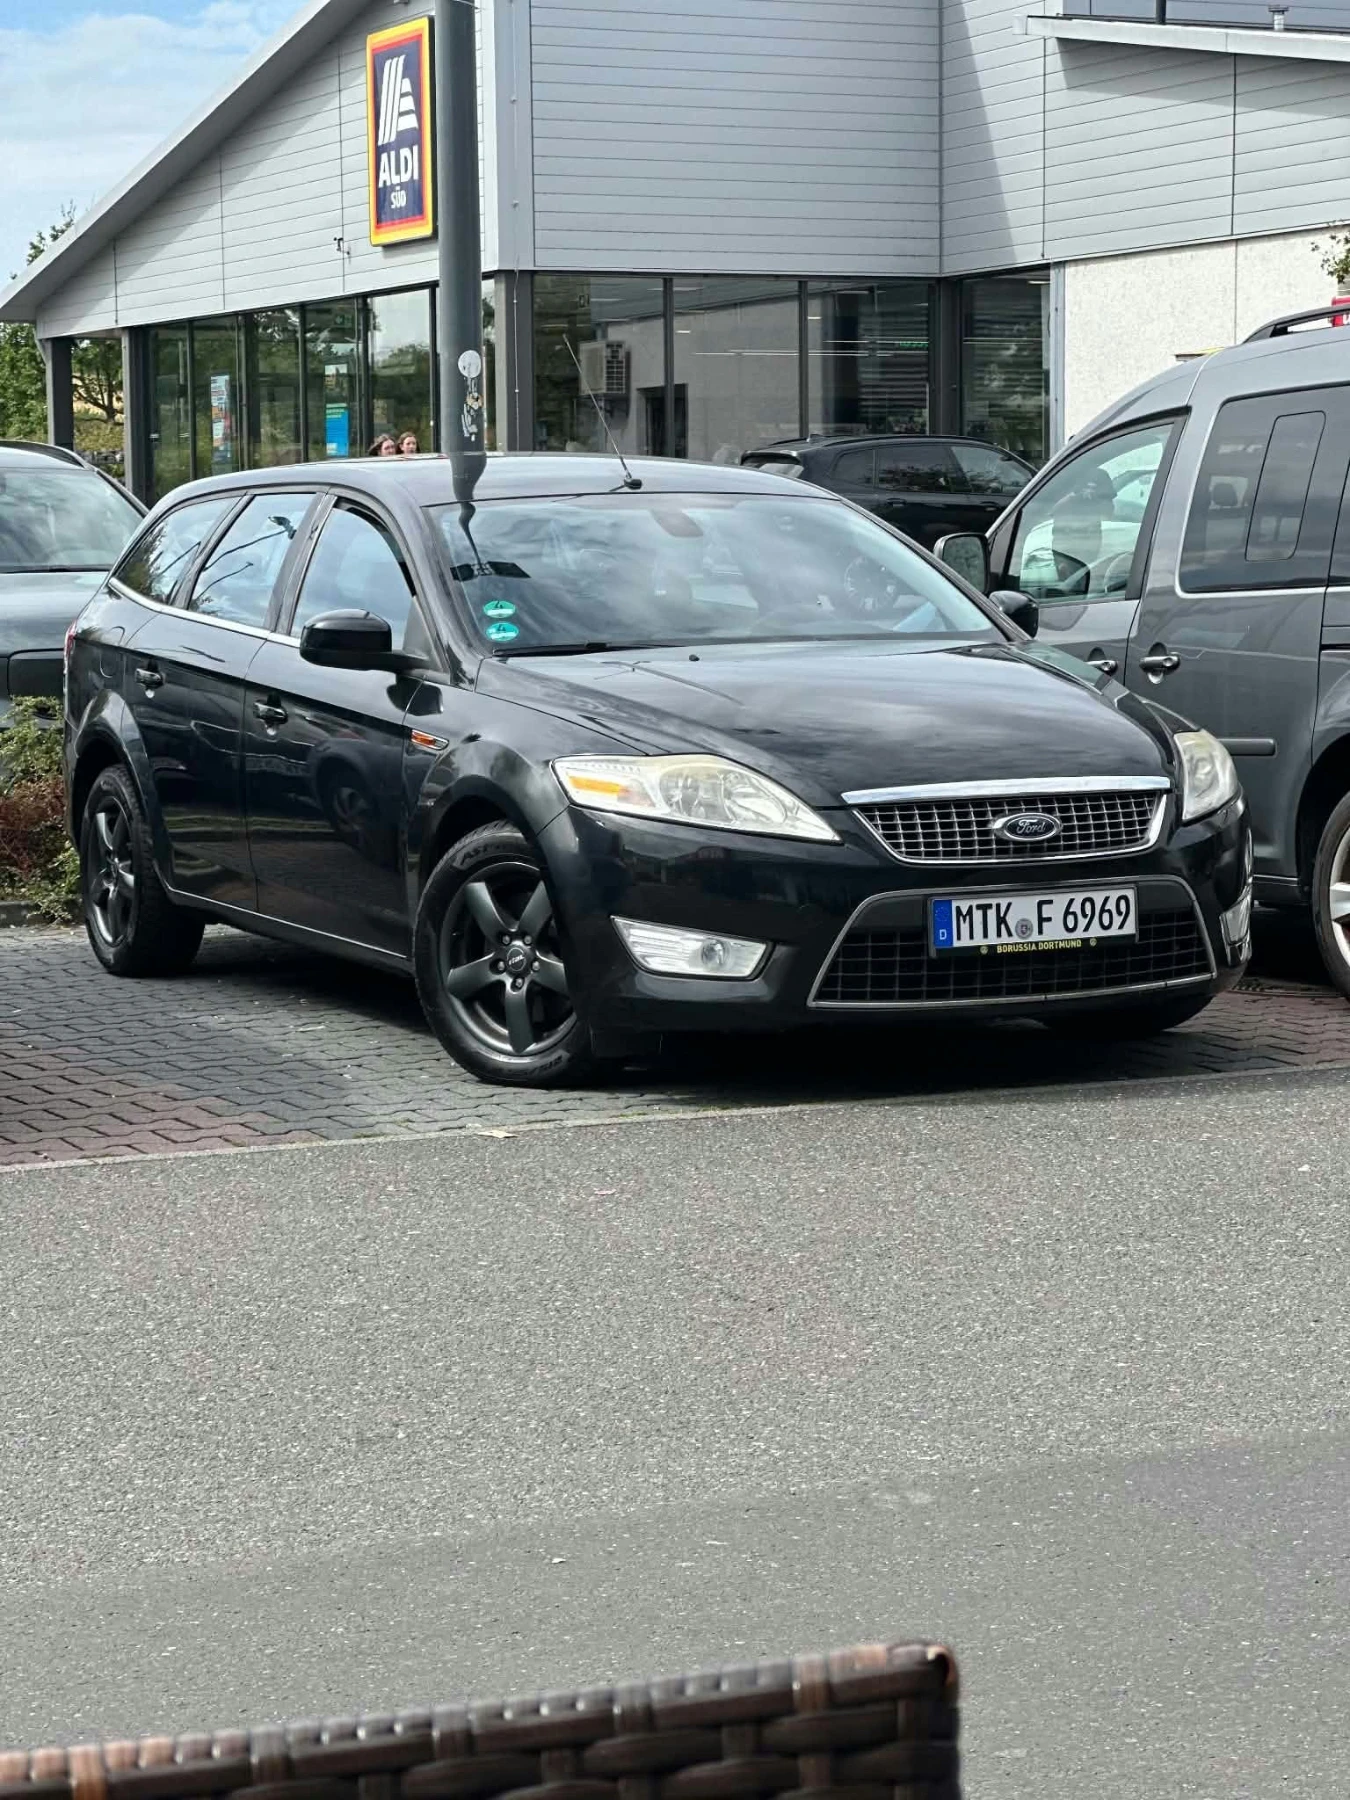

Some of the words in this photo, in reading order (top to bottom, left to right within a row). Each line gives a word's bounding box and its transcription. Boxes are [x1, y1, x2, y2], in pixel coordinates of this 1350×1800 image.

[378, 144, 419, 188] ALDI
[390, 186, 407, 209] SÜD
[1016, 819, 1046, 834] Ford
[955, 902, 1013, 941] MTK
[1037, 899, 1054, 936] F
[1062, 894, 1131, 934] 6969
[939, 929, 947, 940] D
[996, 942, 1037, 954] BORUSSIA
[1038, 938, 1082, 951] DORTMUND
